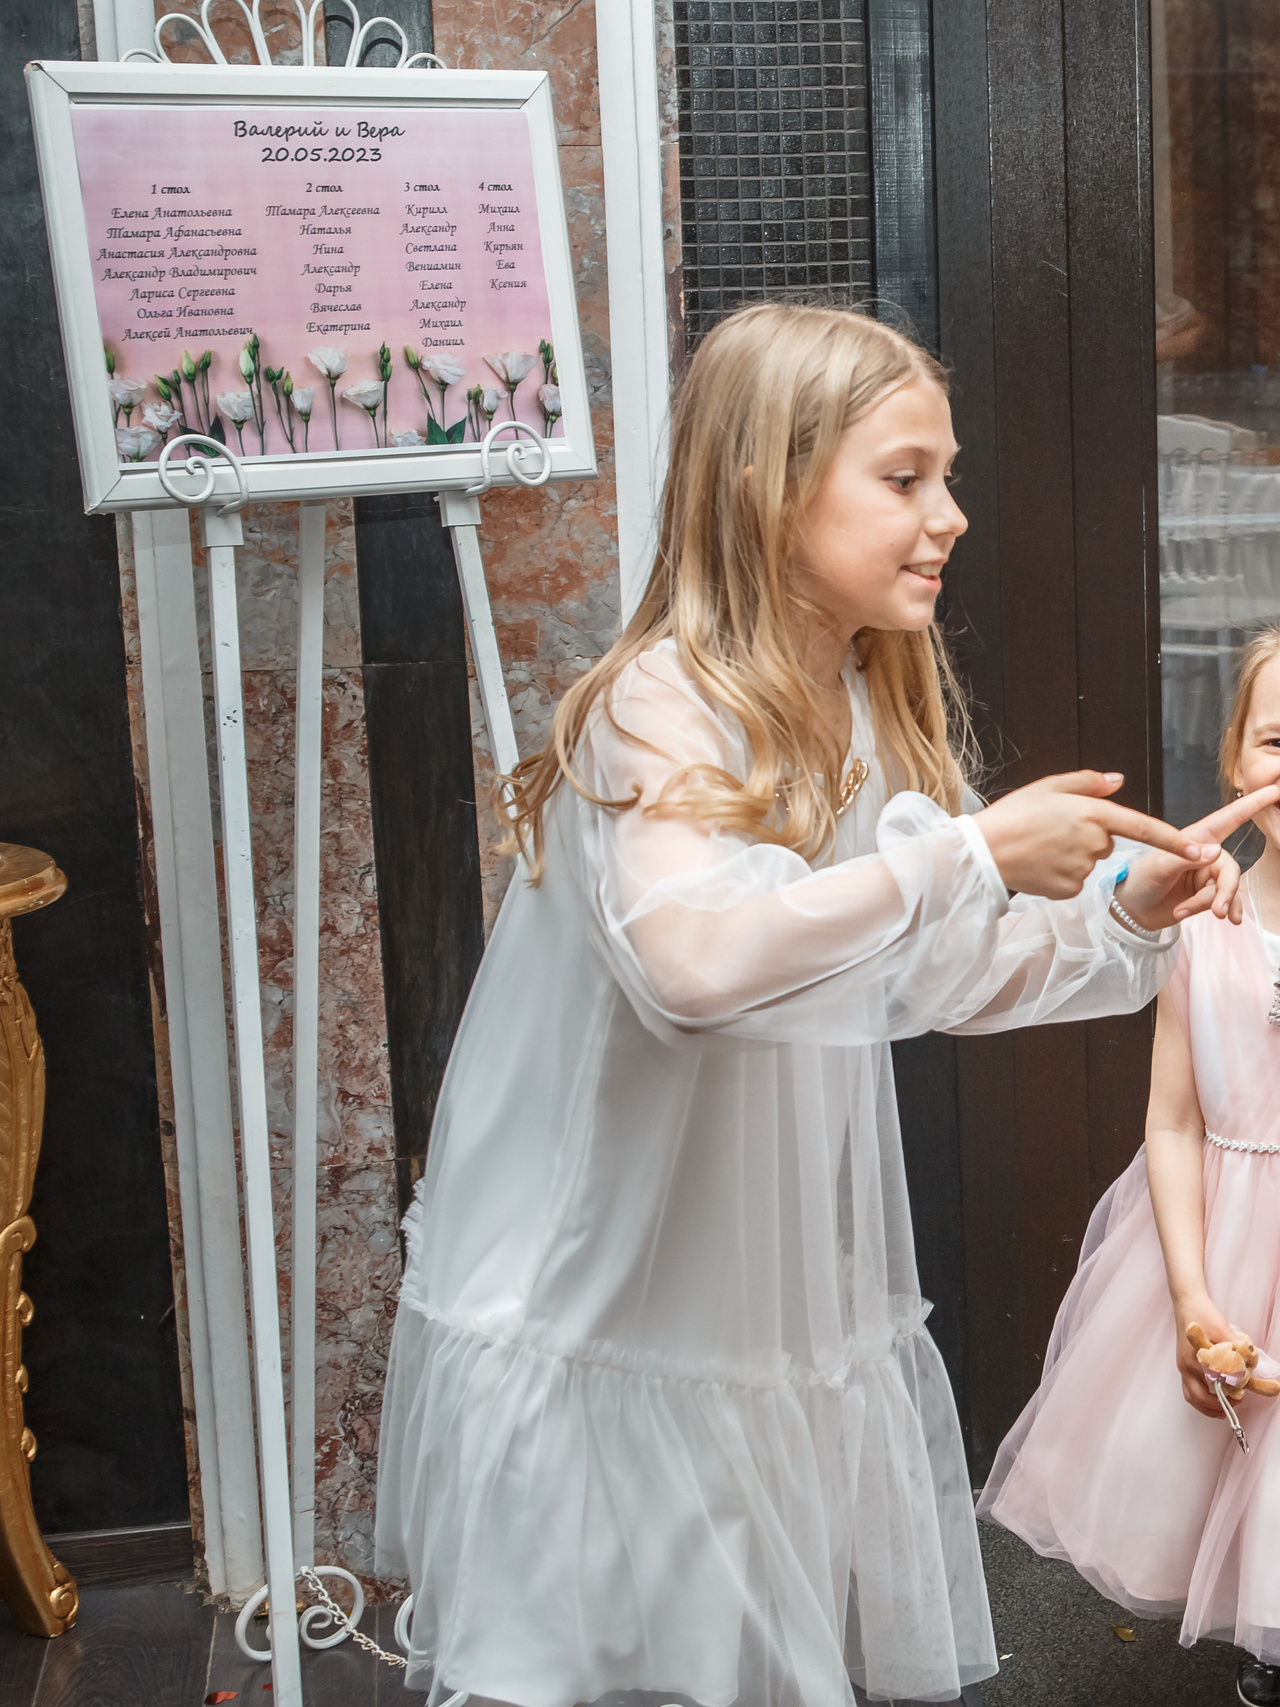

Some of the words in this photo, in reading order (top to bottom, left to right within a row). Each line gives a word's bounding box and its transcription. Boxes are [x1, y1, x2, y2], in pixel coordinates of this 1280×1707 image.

[233, 120, 330, 142] Валерий
[335, 126, 352, 138] и
[356, 121, 406, 143] Вера
[261, 147, 382, 163] 20.05.2023
[150, 184, 157, 195] 1
[160, 186, 191, 195] стол
[305, 182, 313, 193] 2
[315, 184, 344, 193] стол
[404, 182, 410, 192] 3
[413, 184, 441, 192] стол
[478, 181, 485, 192] 4
[487, 183, 514, 192] стол
[111, 207, 149, 219] Елена
[151, 206, 233, 220] Анатольевна
[265, 205, 316, 220] Тамара
[317, 205, 380, 219] Алексеевна
[405, 204, 448, 219] Кирилл
[478, 203, 521, 216] Михаил
[106, 227, 161, 243] Тамара
[163, 225, 242, 241] Афанасьевна
[299, 223, 352, 236] Наталья
[399, 221, 457, 236] Александр
[487, 221, 516, 234] Анна
[96, 248, 165, 261] Анастасия
[166, 244, 258, 261] Александровна
[312, 243, 345, 255] Нина
[405, 242, 457, 254] Светлана
[483, 240, 524, 255] Кирьян
[300, 261, 361, 277] Александр
[405, 261, 461, 272] Вениамин
[495, 259, 516, 270] Ева
[101, 265, 166, 282] Александр
[168, 264, 258, 280] Владимирович
[314, 282, 353, 297] Дарья
[419, 280, 453, 291] Елена
[489, 278, 527, 291] Ксения
[129, 288, 175, 303] Лариса
[178, 286, 236, 302] Сергеевна
[309, 302, 362, 314] Вячеслав
[409, 296, 467, 312] Александр
[137, 307, 174, 319] Ольга
[175, 304, 235, 318] Ивановна
[305, 321, 371, 335] Екатерина
[419, 318, 463, 330] Михаил
[121, 327, 171, 342] Алексей
[172, 326, 254, 341] Анатольевич
[421, 337, 465, 348] Даниил
